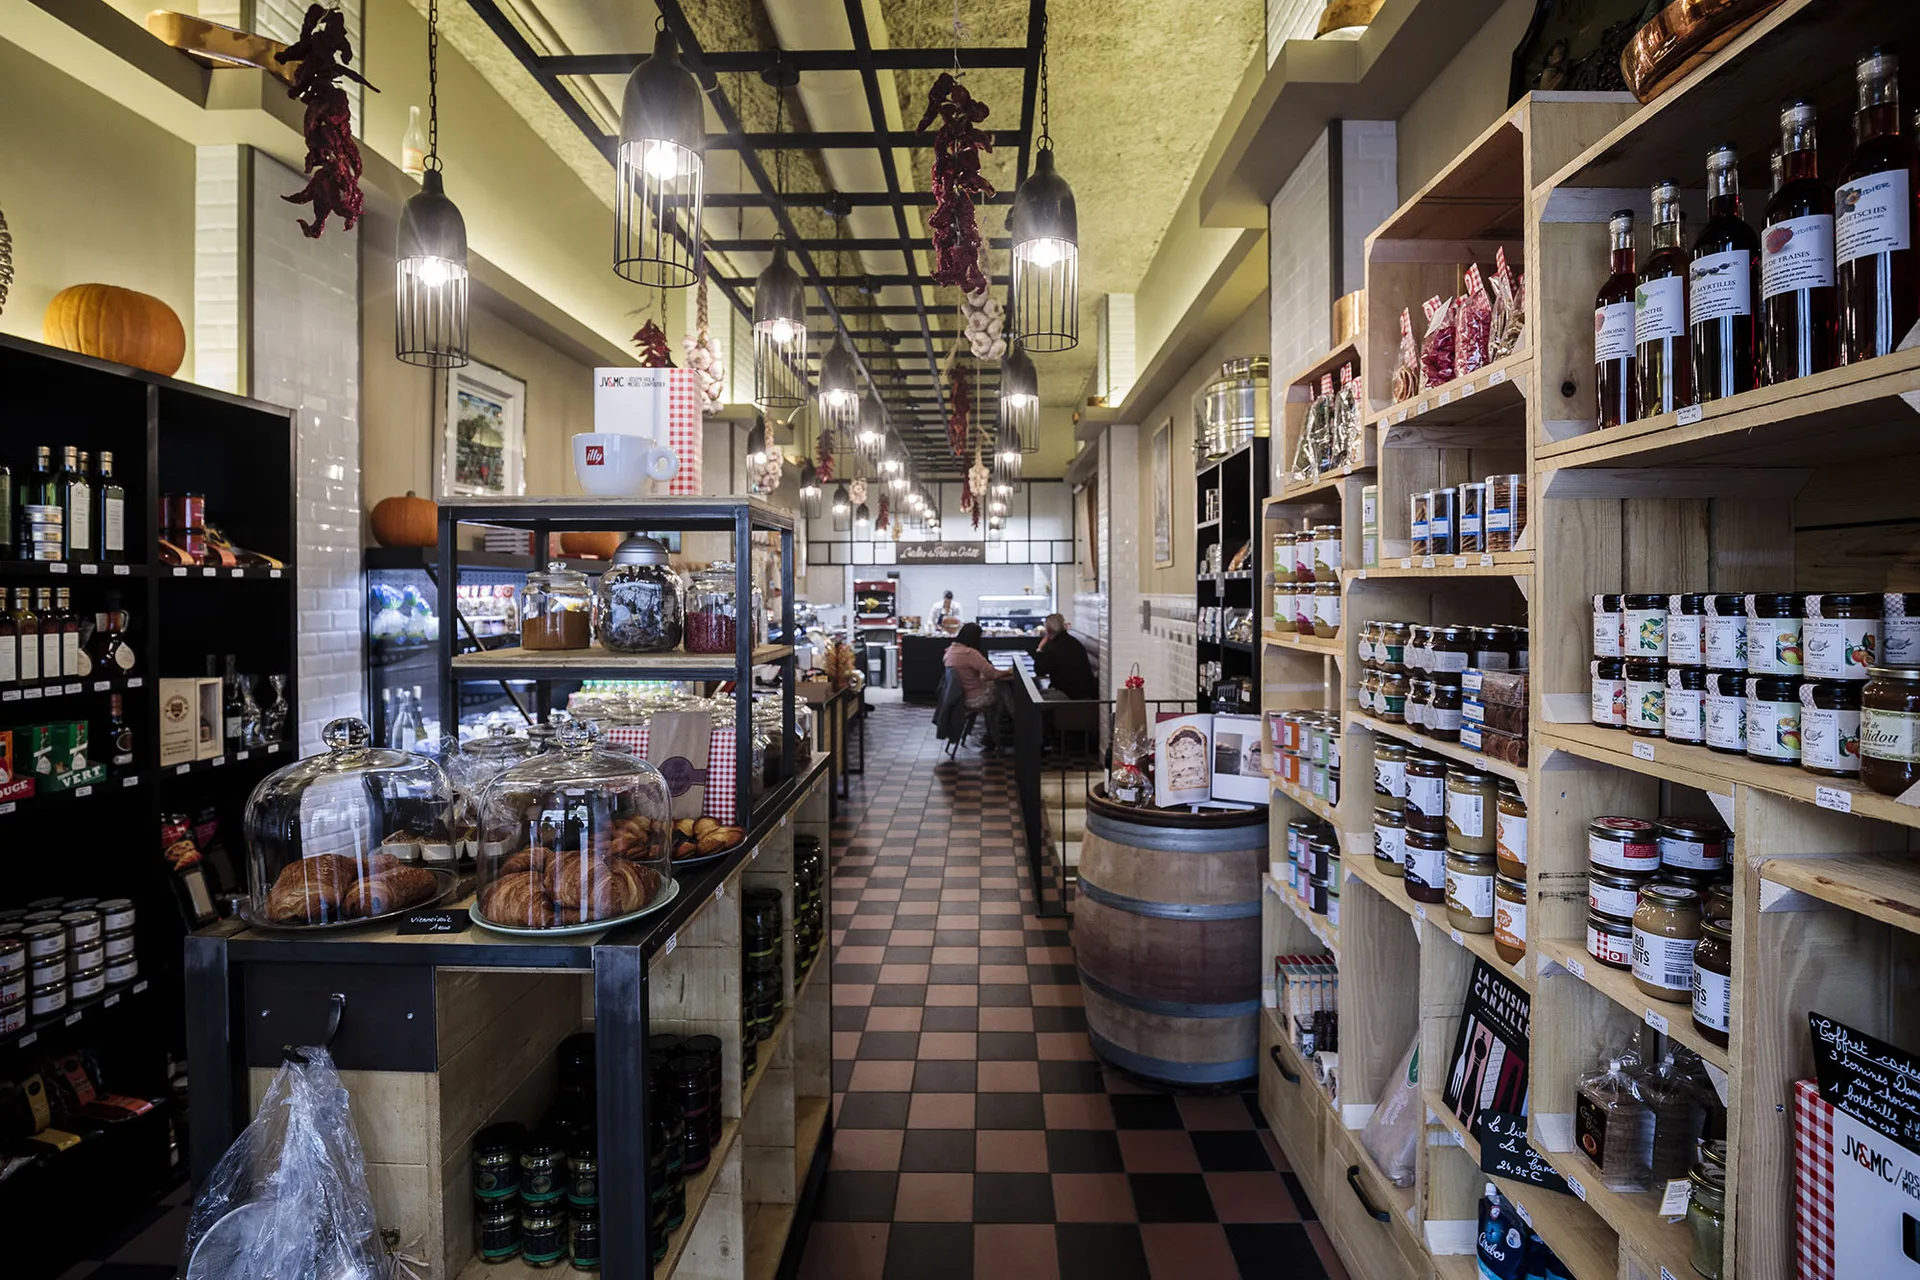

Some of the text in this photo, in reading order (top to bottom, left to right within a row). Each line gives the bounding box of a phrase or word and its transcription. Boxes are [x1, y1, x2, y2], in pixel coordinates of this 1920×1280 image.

[1840, 206, 1887, 225] QUETSCHES
[1778, 251, 1810, 263] FRAISES
[1697, 280, 1736, 292] MYRTILLES
[600, 376, 624, 387] JV&MC
[587, 448, 603, 464] illy
[1863, 729, 1899, 744] lidou
[62, 765, 102, 787] VERT
[1478, 967, 1529, 1019] LA CUISIN
[1474, 982, 1530, 1040] CANAILLE
[1829, 1050, 1838, 1061] 3
[1840, 1055, 1888, 1086] terrines
[1876, 1055, 1920, 1082] cade
[1852, 1078, 1871, 1091] au
[1843, 1085, 1900, 1125] bouteille
[1488, 1115, 1501, 1133] Le
[1499, 1138, 1519, 1154] La
[1841, 1134, 1893, 1183] JV&MC
[1902, 1169, 1920, 1188] JOS
